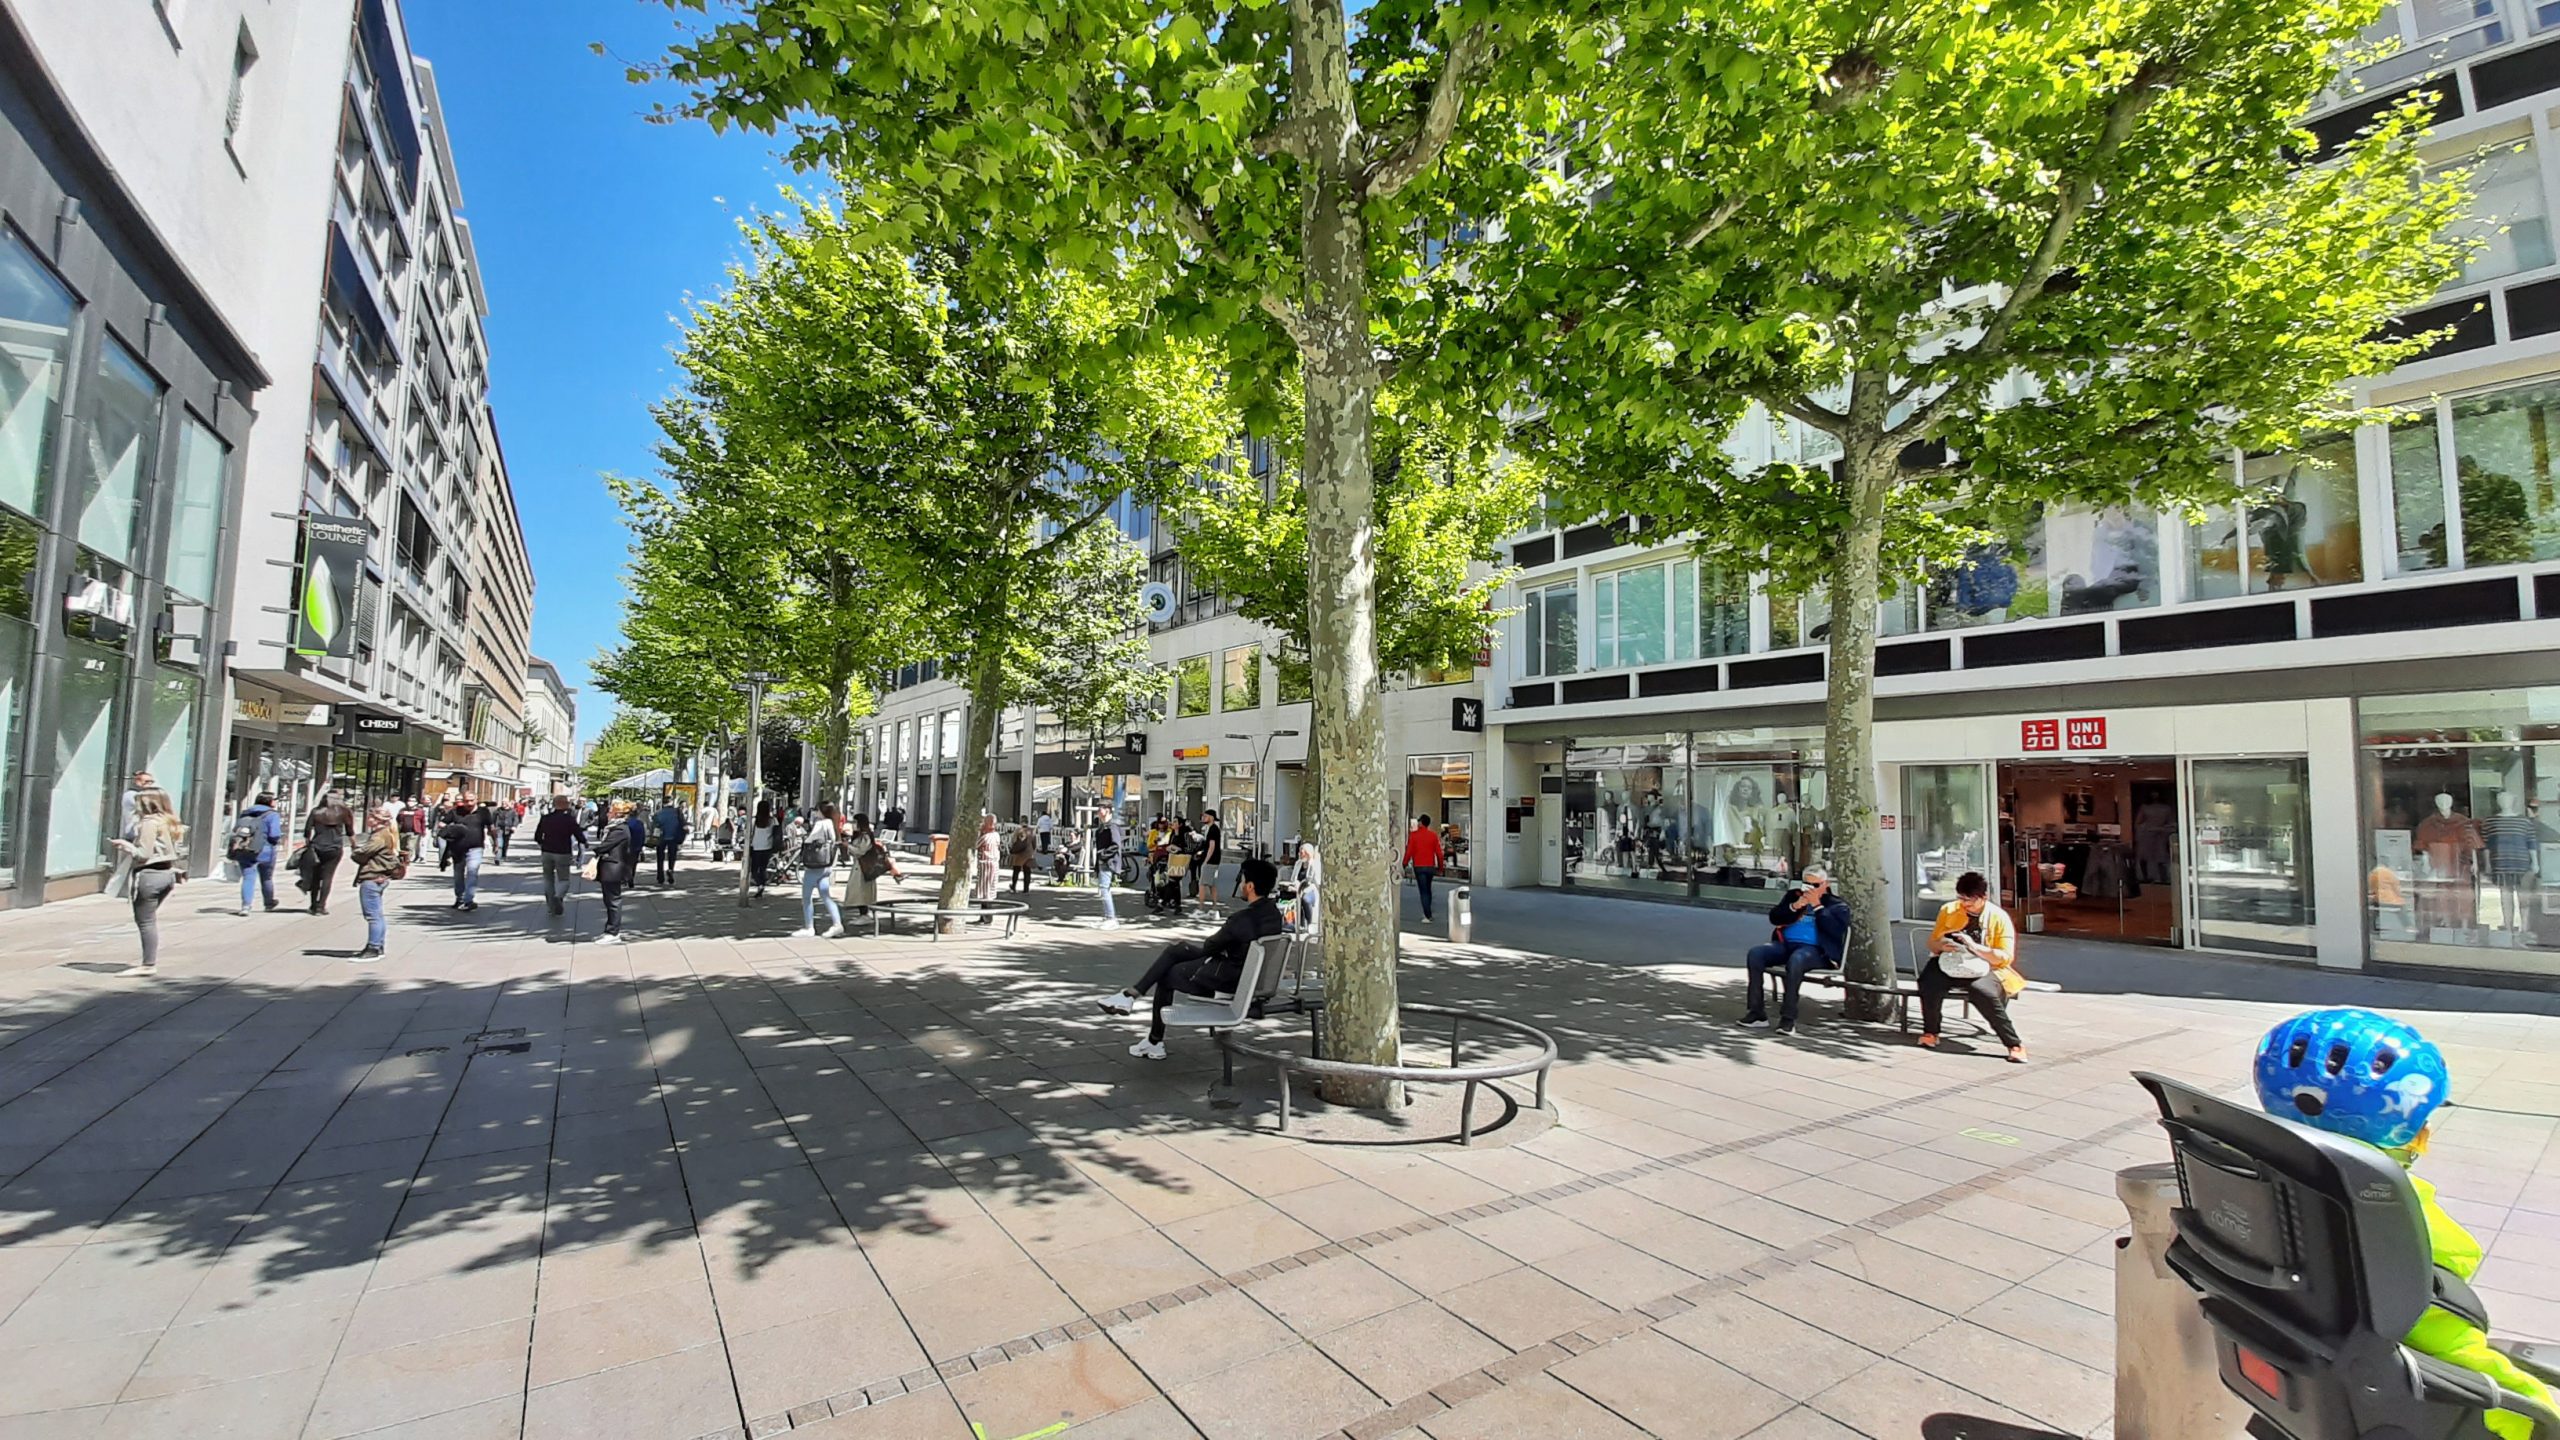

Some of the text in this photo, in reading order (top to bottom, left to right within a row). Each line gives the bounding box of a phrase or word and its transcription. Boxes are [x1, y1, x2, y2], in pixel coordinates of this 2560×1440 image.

[311, 522, 367, 536] aesthetic
[310, 531, 366, 545] LOUNGE
[359, 719, 399, 729] CHRIST
